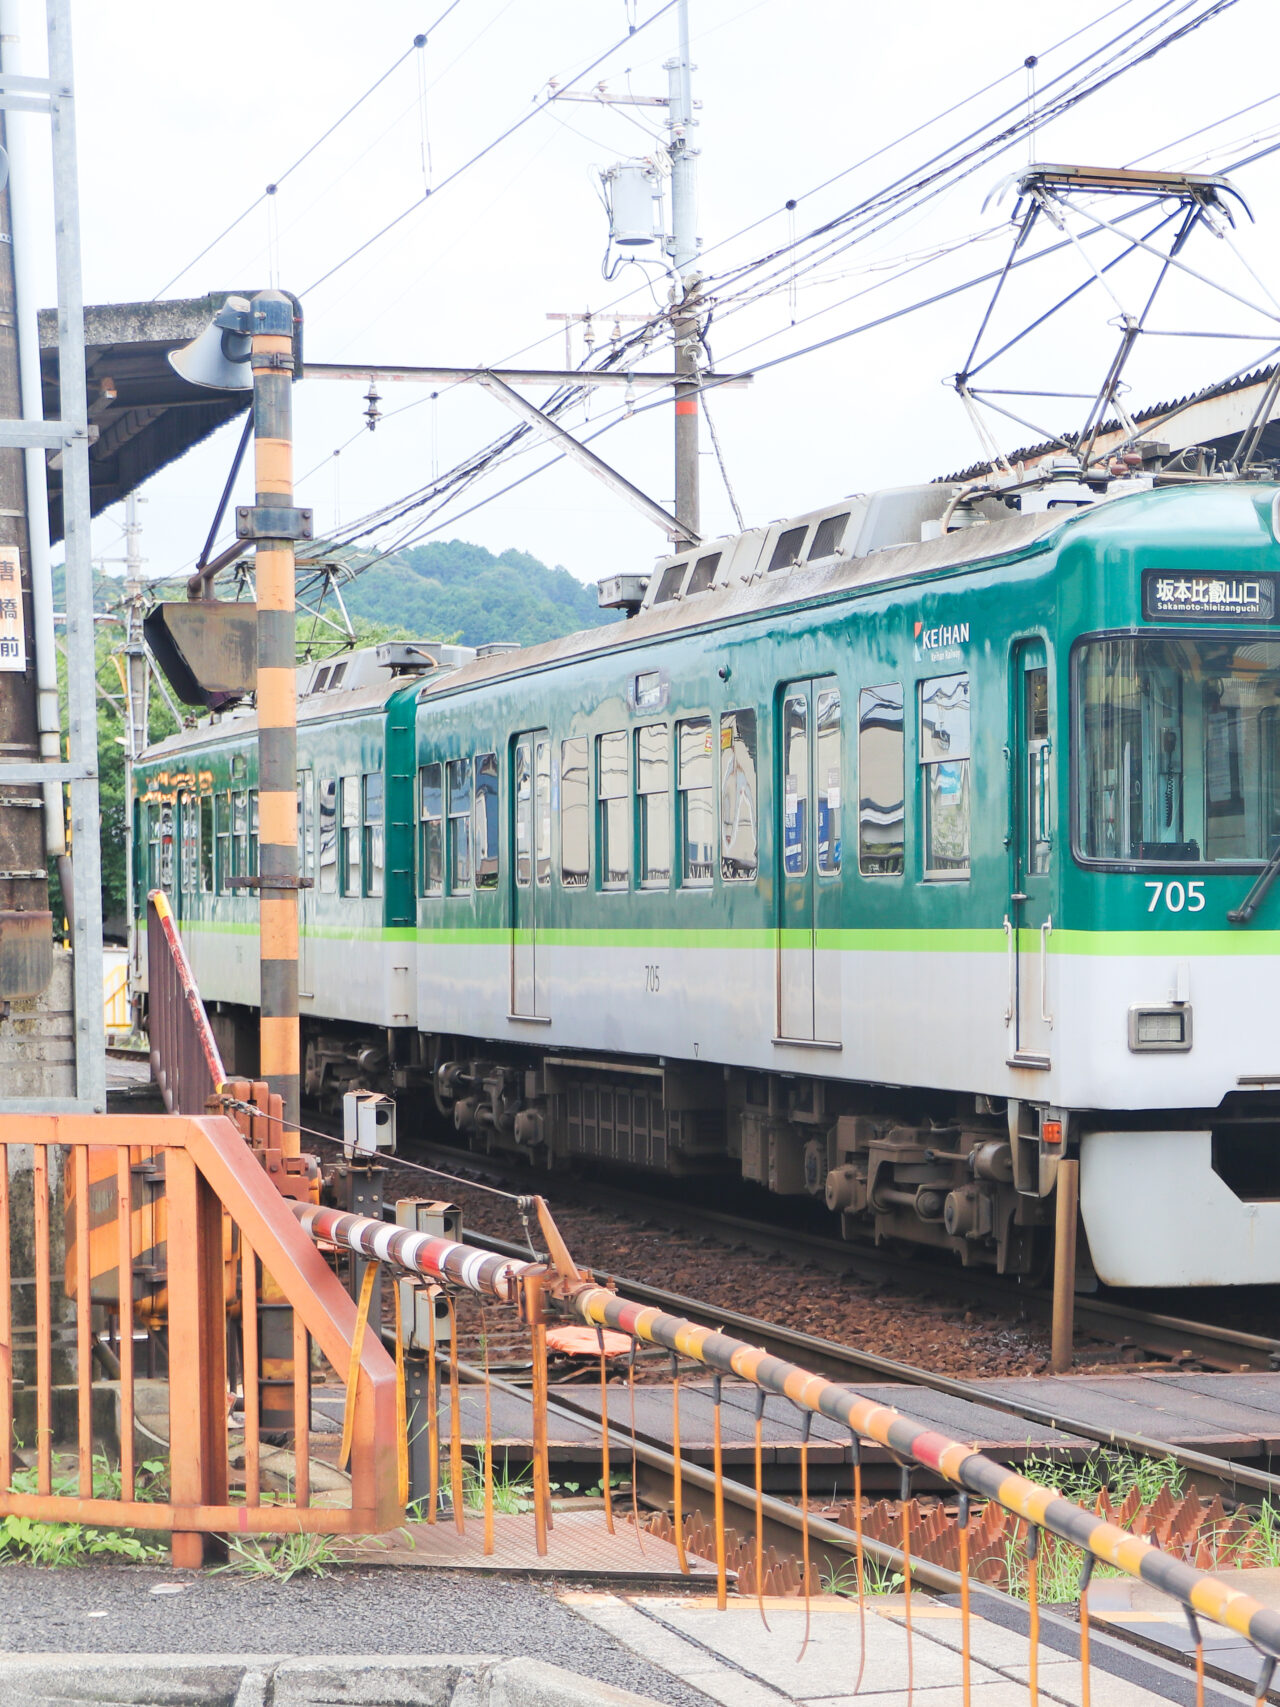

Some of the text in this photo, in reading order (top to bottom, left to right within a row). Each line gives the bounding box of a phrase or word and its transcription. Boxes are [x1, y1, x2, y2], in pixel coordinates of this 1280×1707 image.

[1156, 578, 1260, 604] 坂本比叡山口
[1157, 602, 1259, 614] Sakamoto-hieizanguchi
[922, 622, 970, 650] KEIHAN
[1144, 881, 1206, 912] 705
[645, 964, 660, 993] 705
